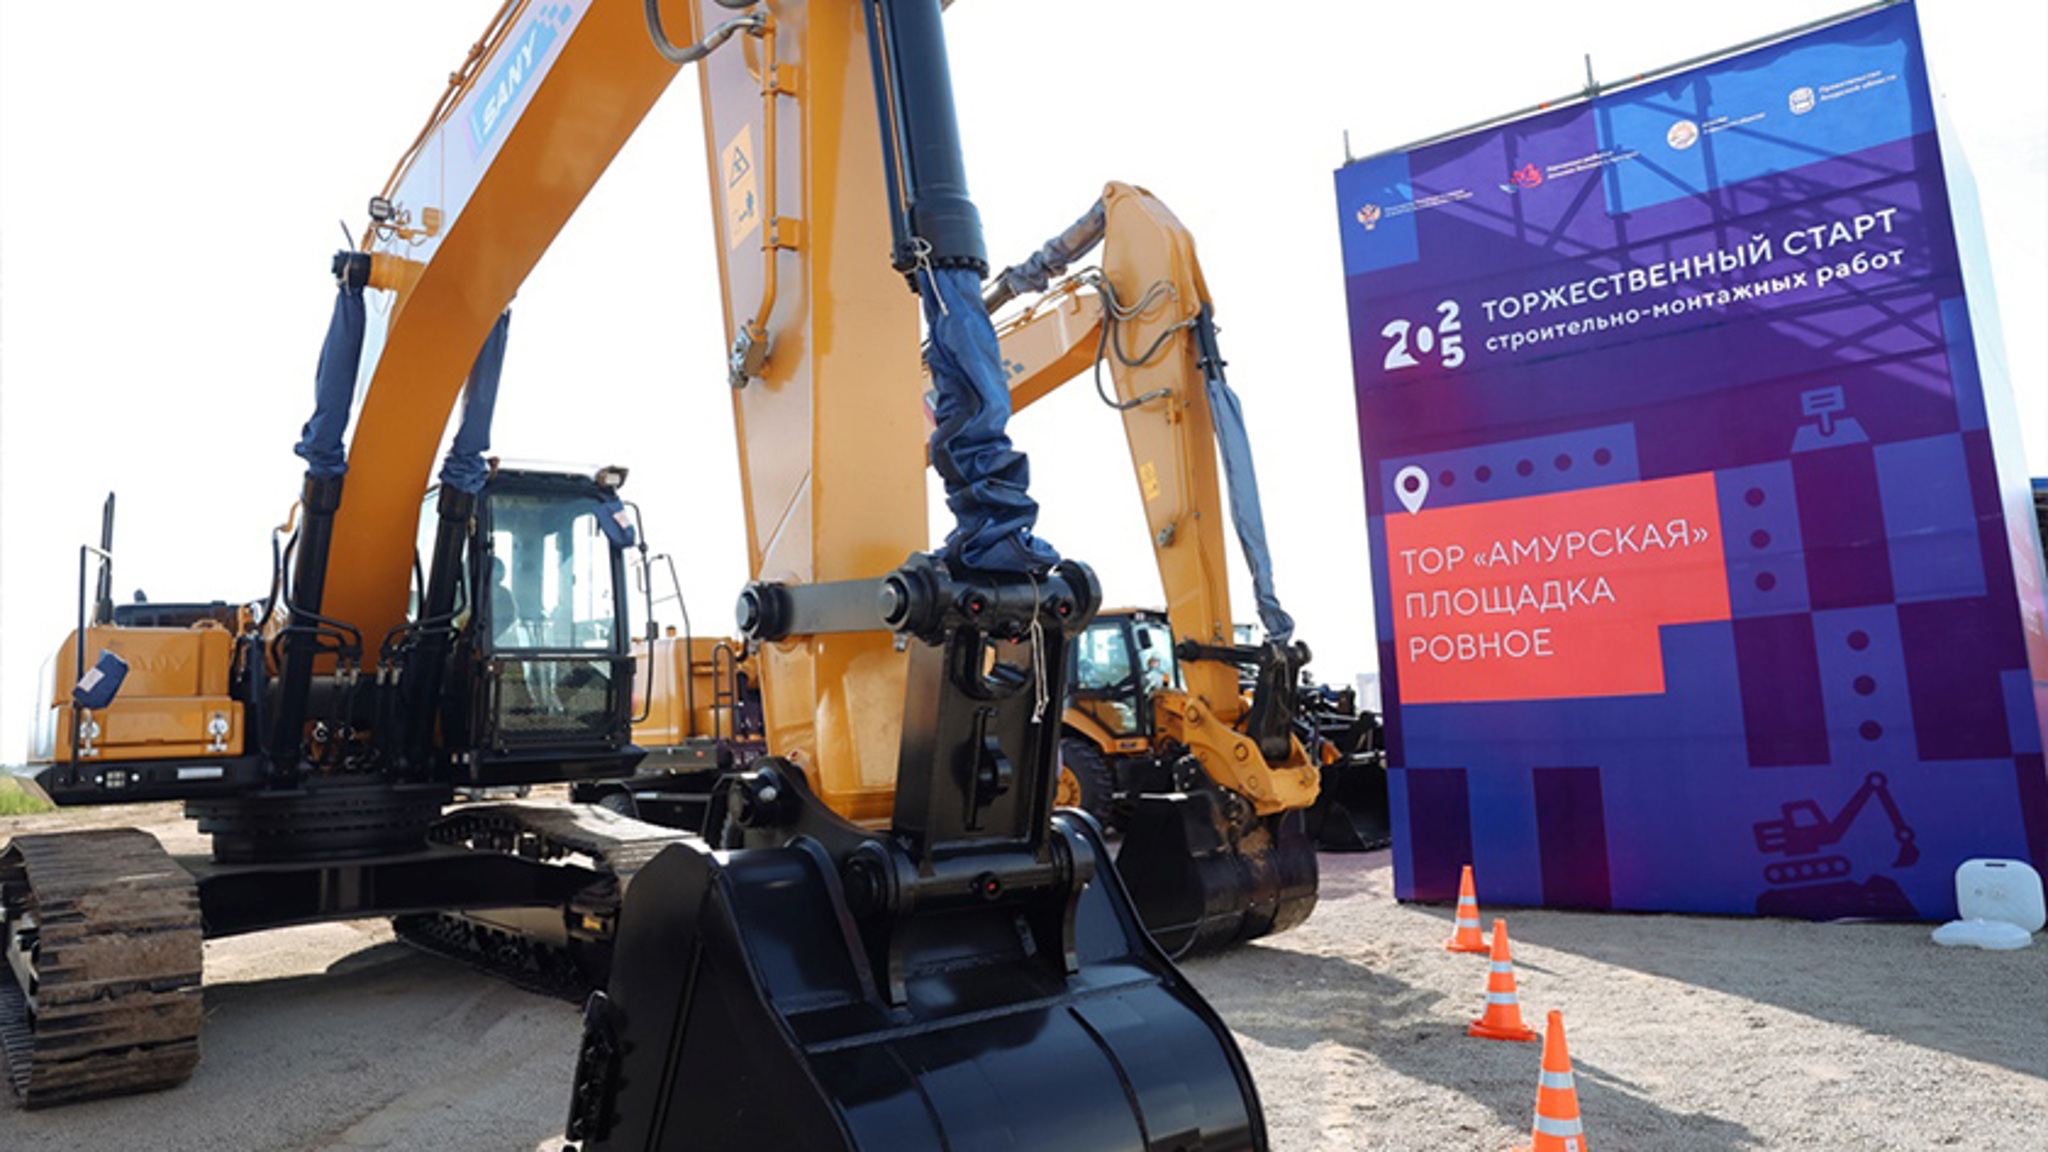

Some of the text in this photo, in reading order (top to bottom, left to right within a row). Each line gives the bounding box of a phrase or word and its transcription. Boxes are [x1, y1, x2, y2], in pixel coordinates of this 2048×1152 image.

[483, 27, 537, 135] SANY
[1482, 207, 1898, 322] ТОРЖЕСТВЕННЫЙ СТАРТ
[1486, 249, 1904, 351] строительно-монтажных работ
[1400, 519, 1709, 575] ТОР «АМУРСКАЯ»
[1405, 577, 1616, 619] ПЛОЩАДКА
[1409, 628, 1553, 662] РОВНОЕ
